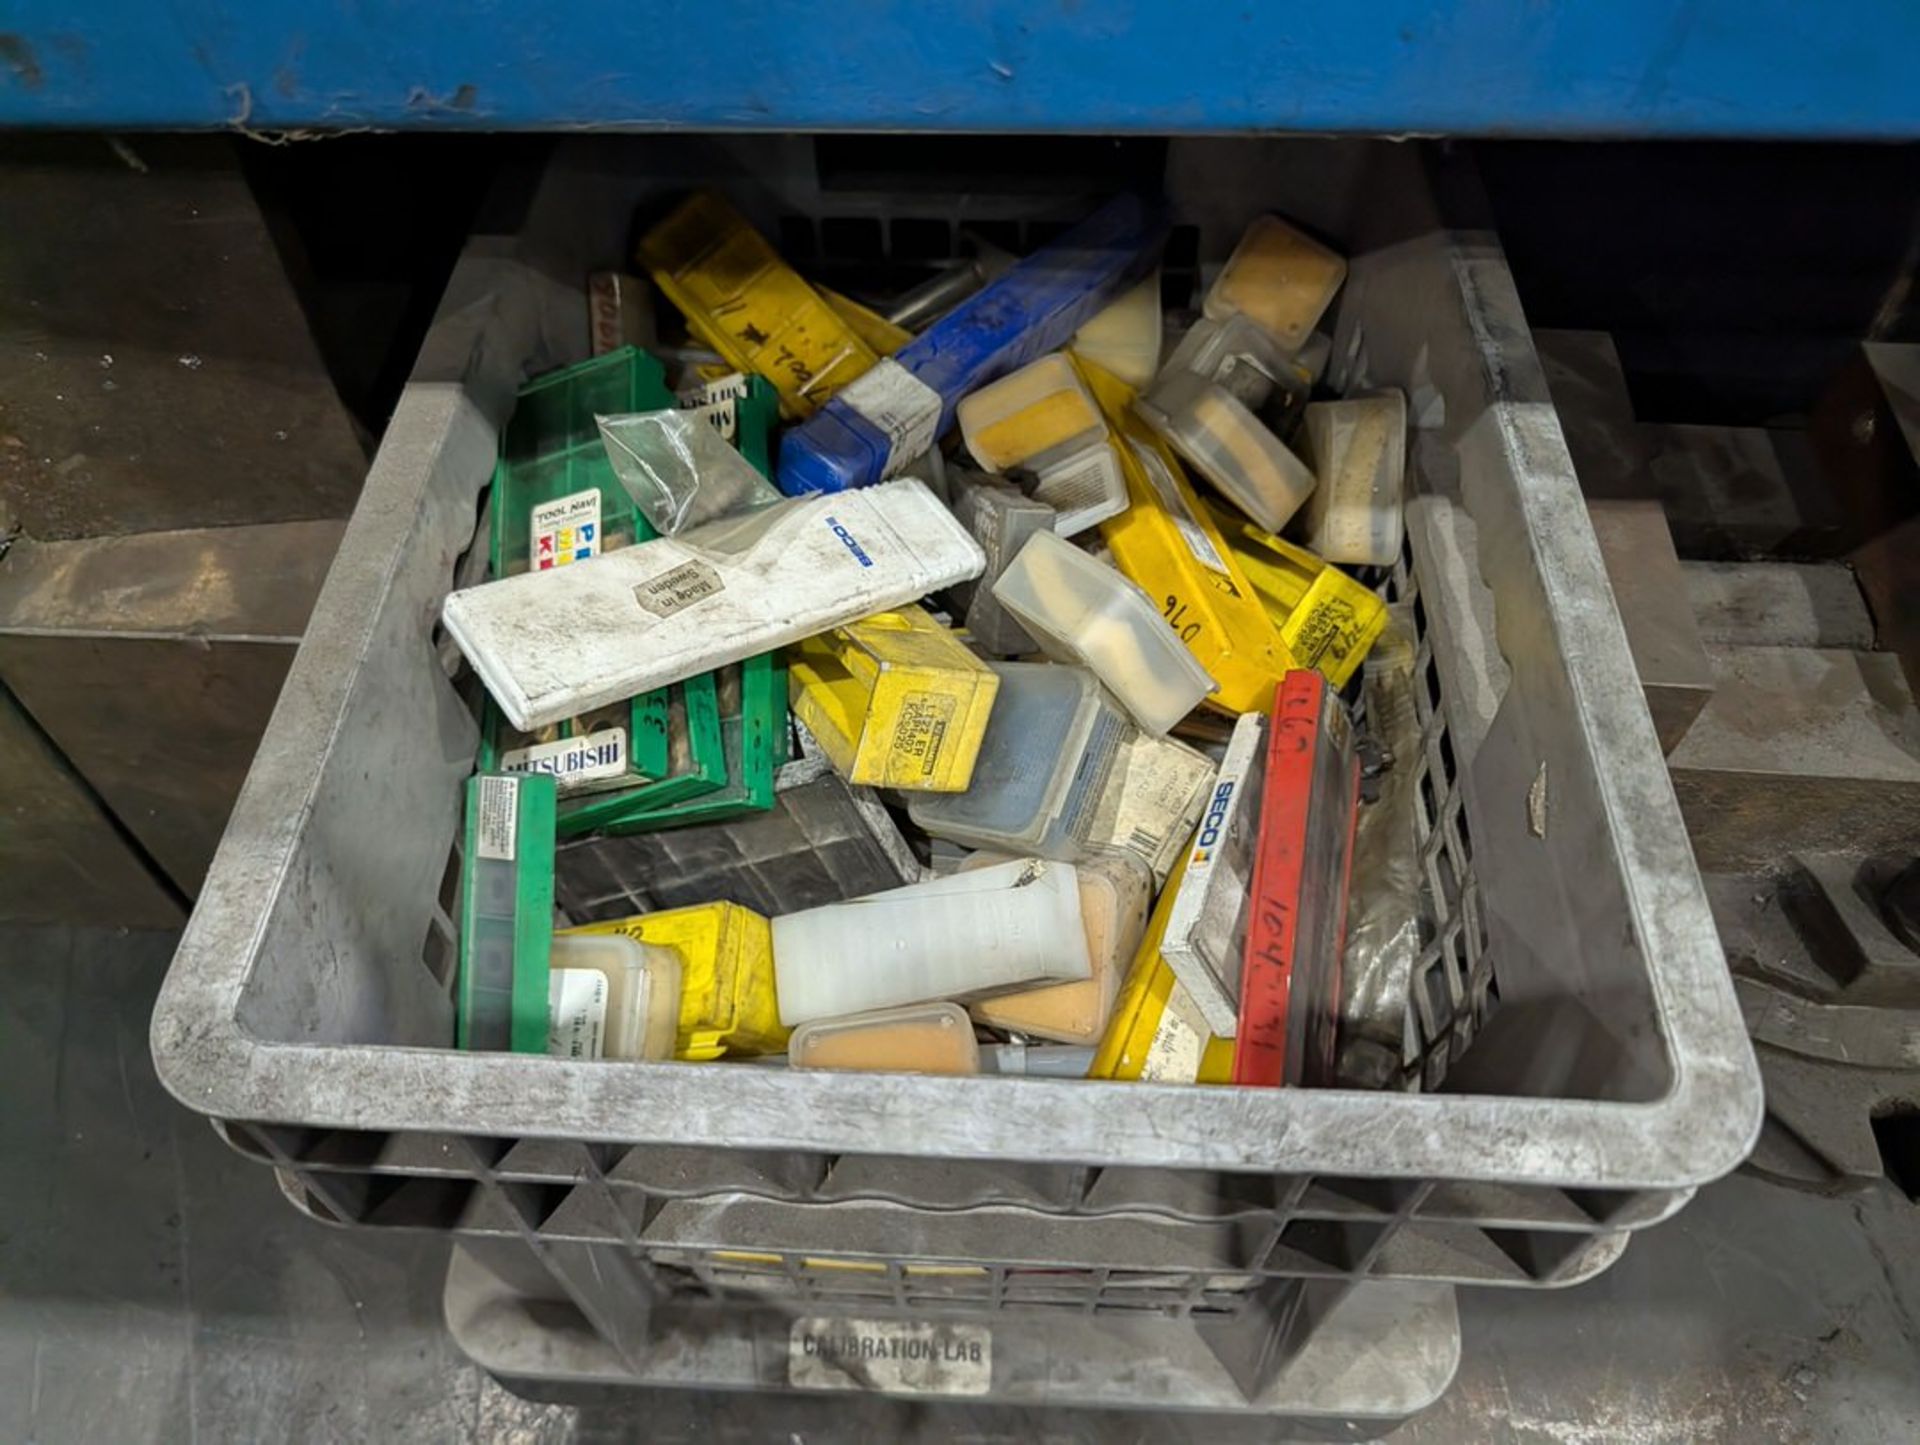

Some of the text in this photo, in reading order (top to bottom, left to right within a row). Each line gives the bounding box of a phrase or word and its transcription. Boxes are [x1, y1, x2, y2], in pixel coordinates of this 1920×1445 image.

[537, 505, 567, 526] TOOL
[832, 524, 874, 568] SECO
[648, 567, 700, 596] Sweden
[678, 580, 713, 602] Made
[507, 734, 619, 777] ITSUBISHI
[1199, 781, 1235, 847] SECO
[803, 1334, 982, 1362] CALIBRATION LAB
